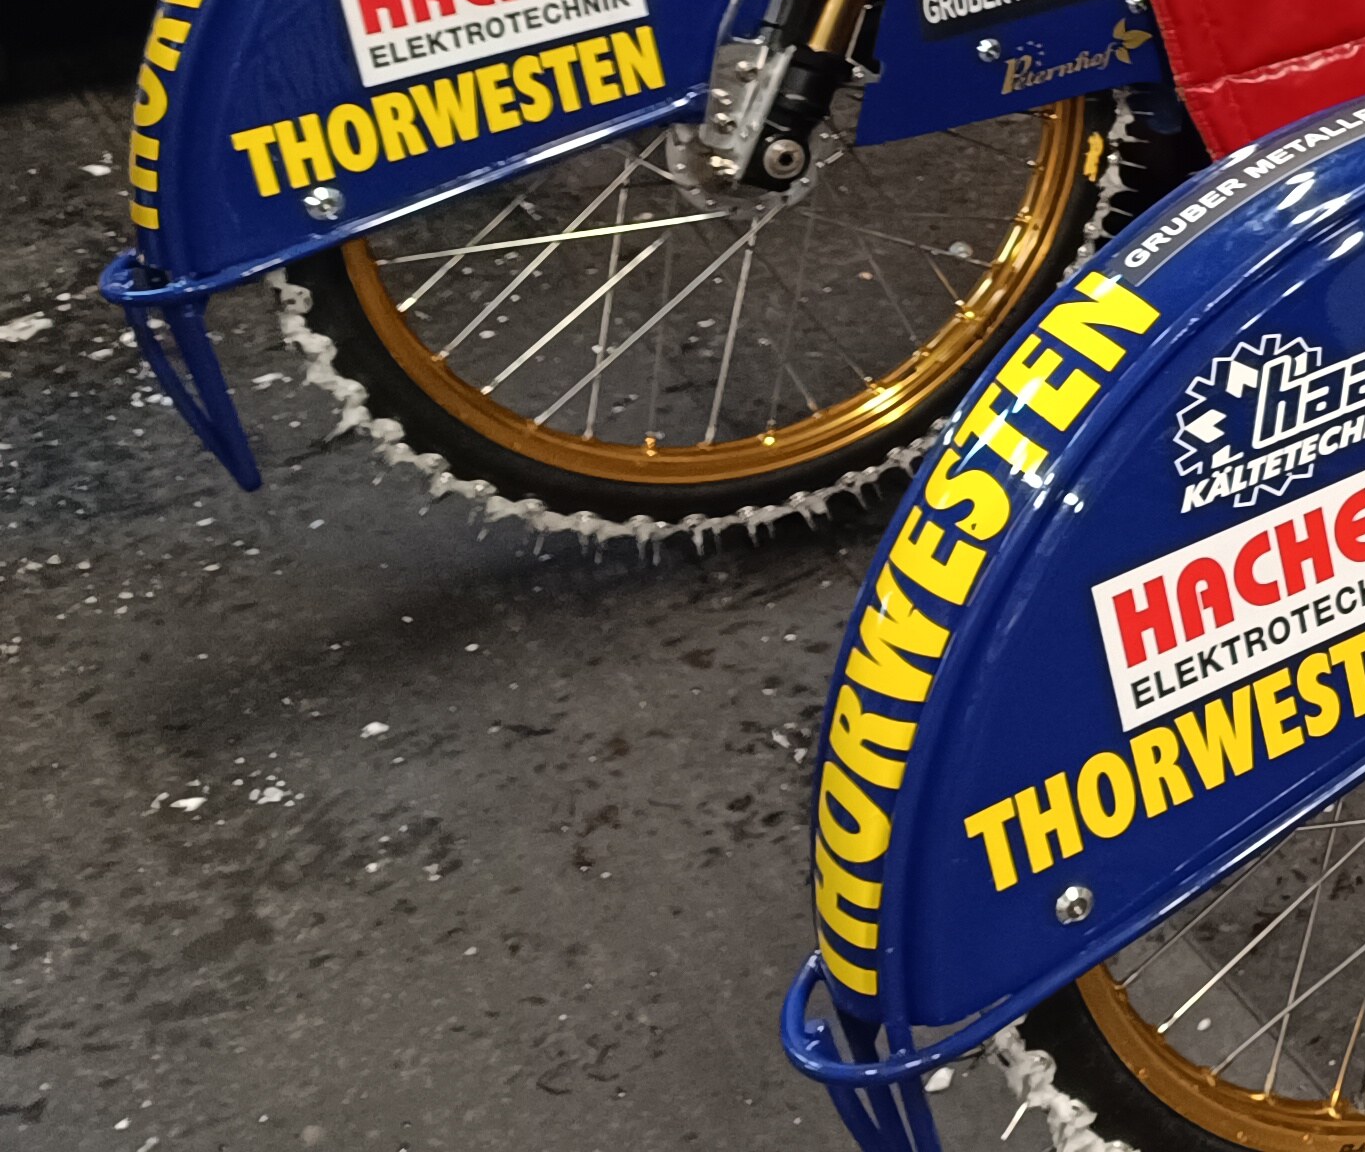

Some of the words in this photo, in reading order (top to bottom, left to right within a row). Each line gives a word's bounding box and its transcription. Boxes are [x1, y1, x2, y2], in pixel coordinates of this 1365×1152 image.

[231, 25, 666, 198] THORWESTEN
[1123, 177, 1247, 269] GRUBER
[814, 272, 1162, 996] THORWESTEN
